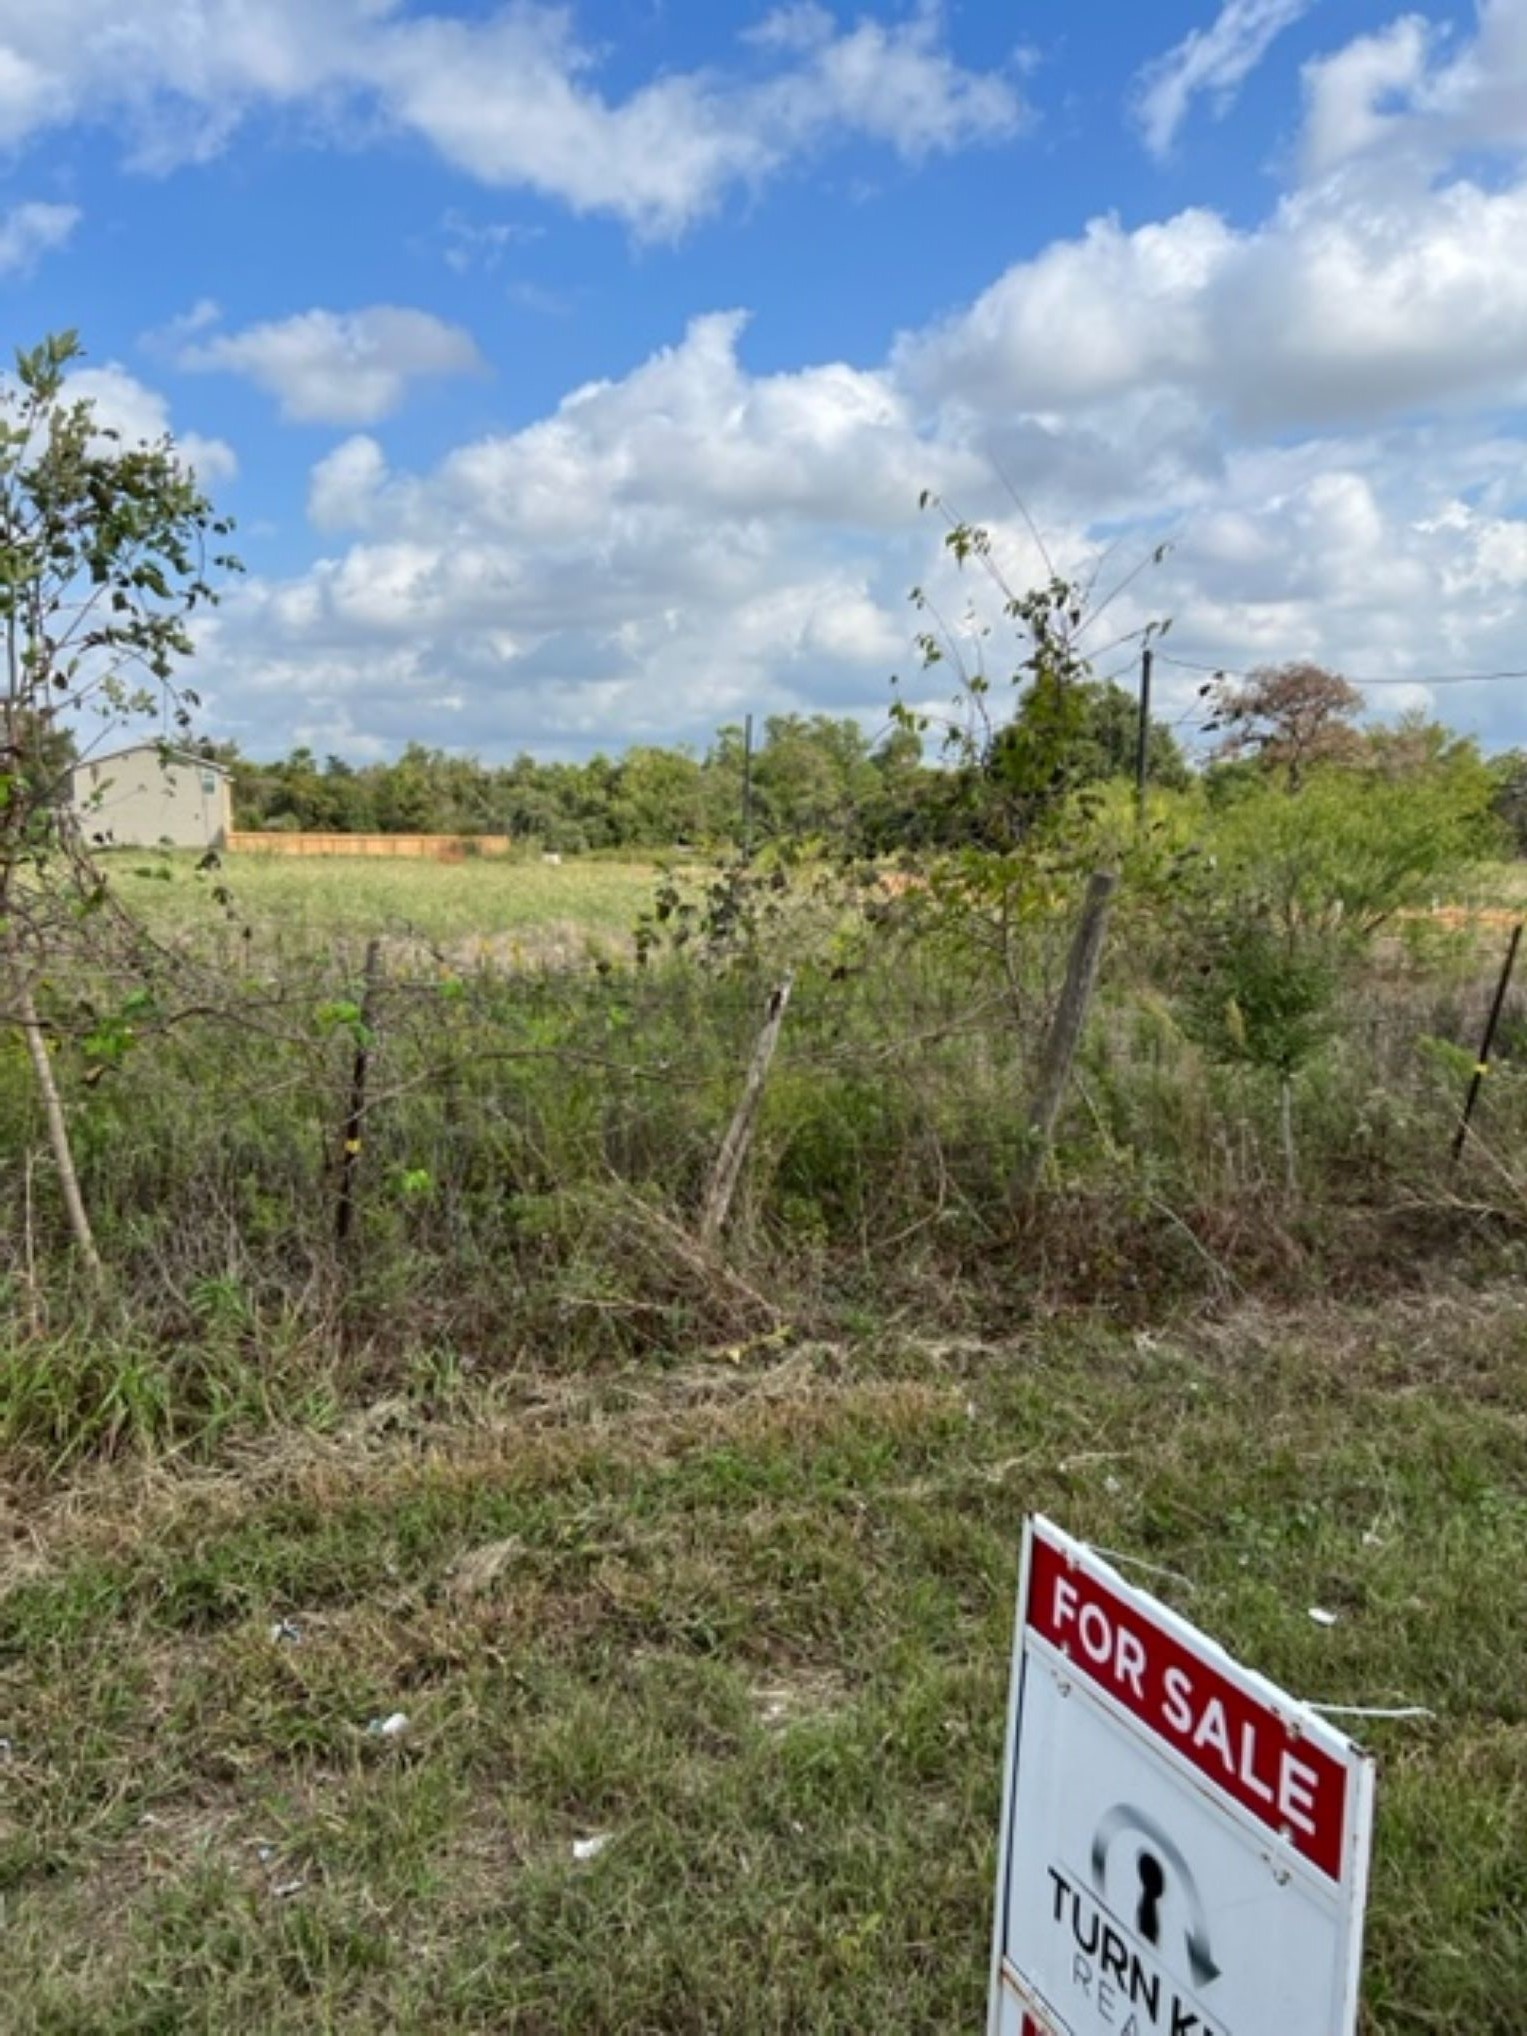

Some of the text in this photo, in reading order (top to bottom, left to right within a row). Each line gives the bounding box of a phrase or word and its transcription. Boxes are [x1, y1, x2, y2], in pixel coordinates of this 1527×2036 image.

[1053, 1576, 1319, 1836] FOR SALE
[1048, 1865, 1214, 2036] TURN K
